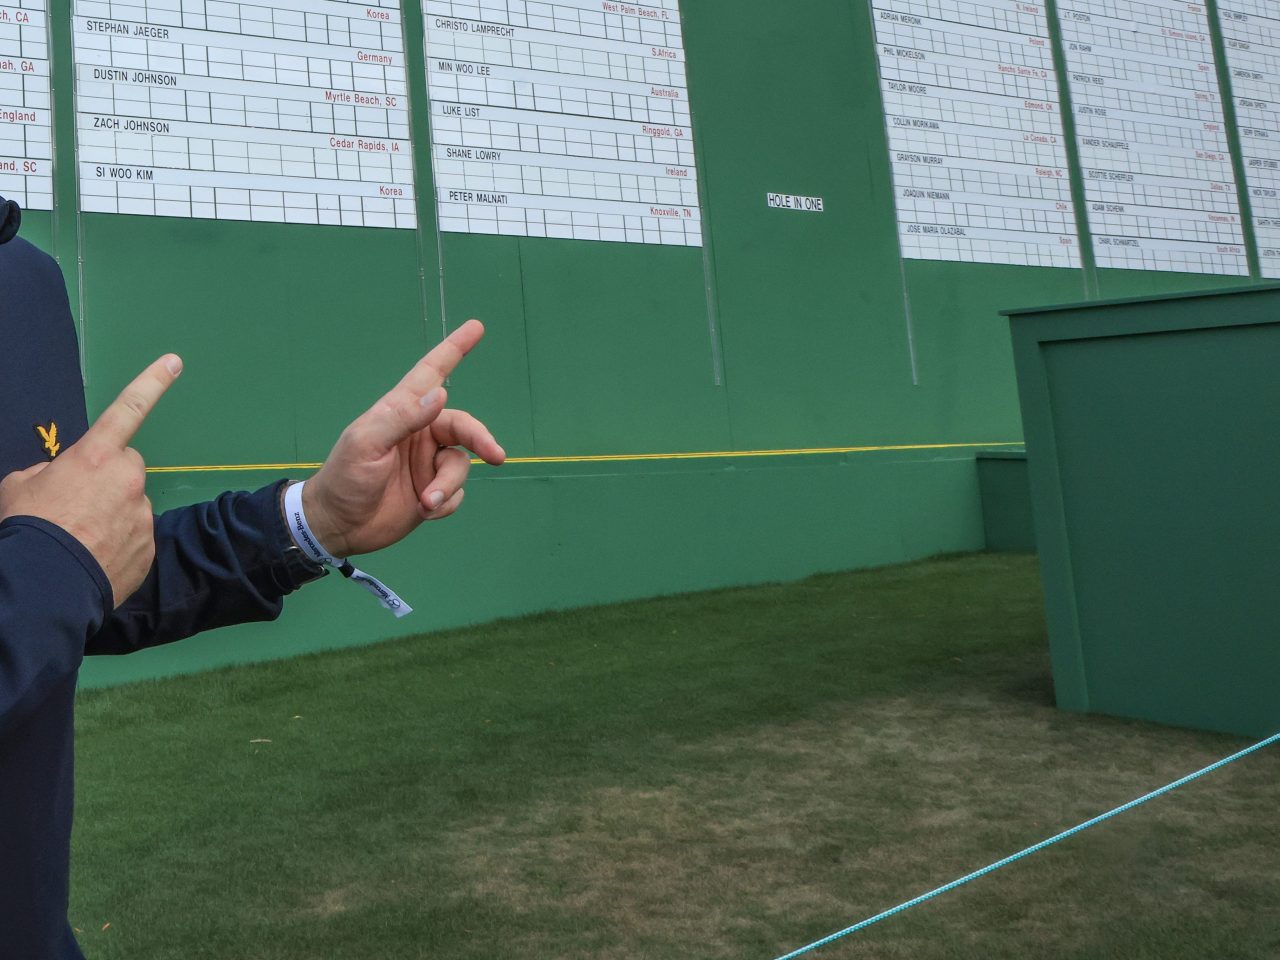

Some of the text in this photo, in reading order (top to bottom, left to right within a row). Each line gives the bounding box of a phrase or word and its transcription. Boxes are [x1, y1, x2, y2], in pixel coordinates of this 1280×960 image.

[367, 9, 389, 21] Korea
[87, 21, 168, 39] STEPHAN JAEGER
[436, 19, 514, 37] CHRISTO LAMPRECHT
[358, 52, 392, 64] Germany
[439, 62, 490, 75] MIN WOO LEE
[94, 69, 176, 86] DUSTIN JOHNSON
[324, 91, 396, 107] Myrtle Beach, SC
[330, 138, 399, 153] Cedar Rapids, IA
[447, 148, 500, 160] SHANE LOWRY
[96, 167, 153, 180] SI WOO KIM
[666, 167, 688, 176] Ireland
[378, 186, 404, 196] Korea
[450, 191, 507, 204] PETER MALNATI
[769, 194, 821, 211] HOLE IN ONE
[650, 207, 692, 218] Knoxville, TN
